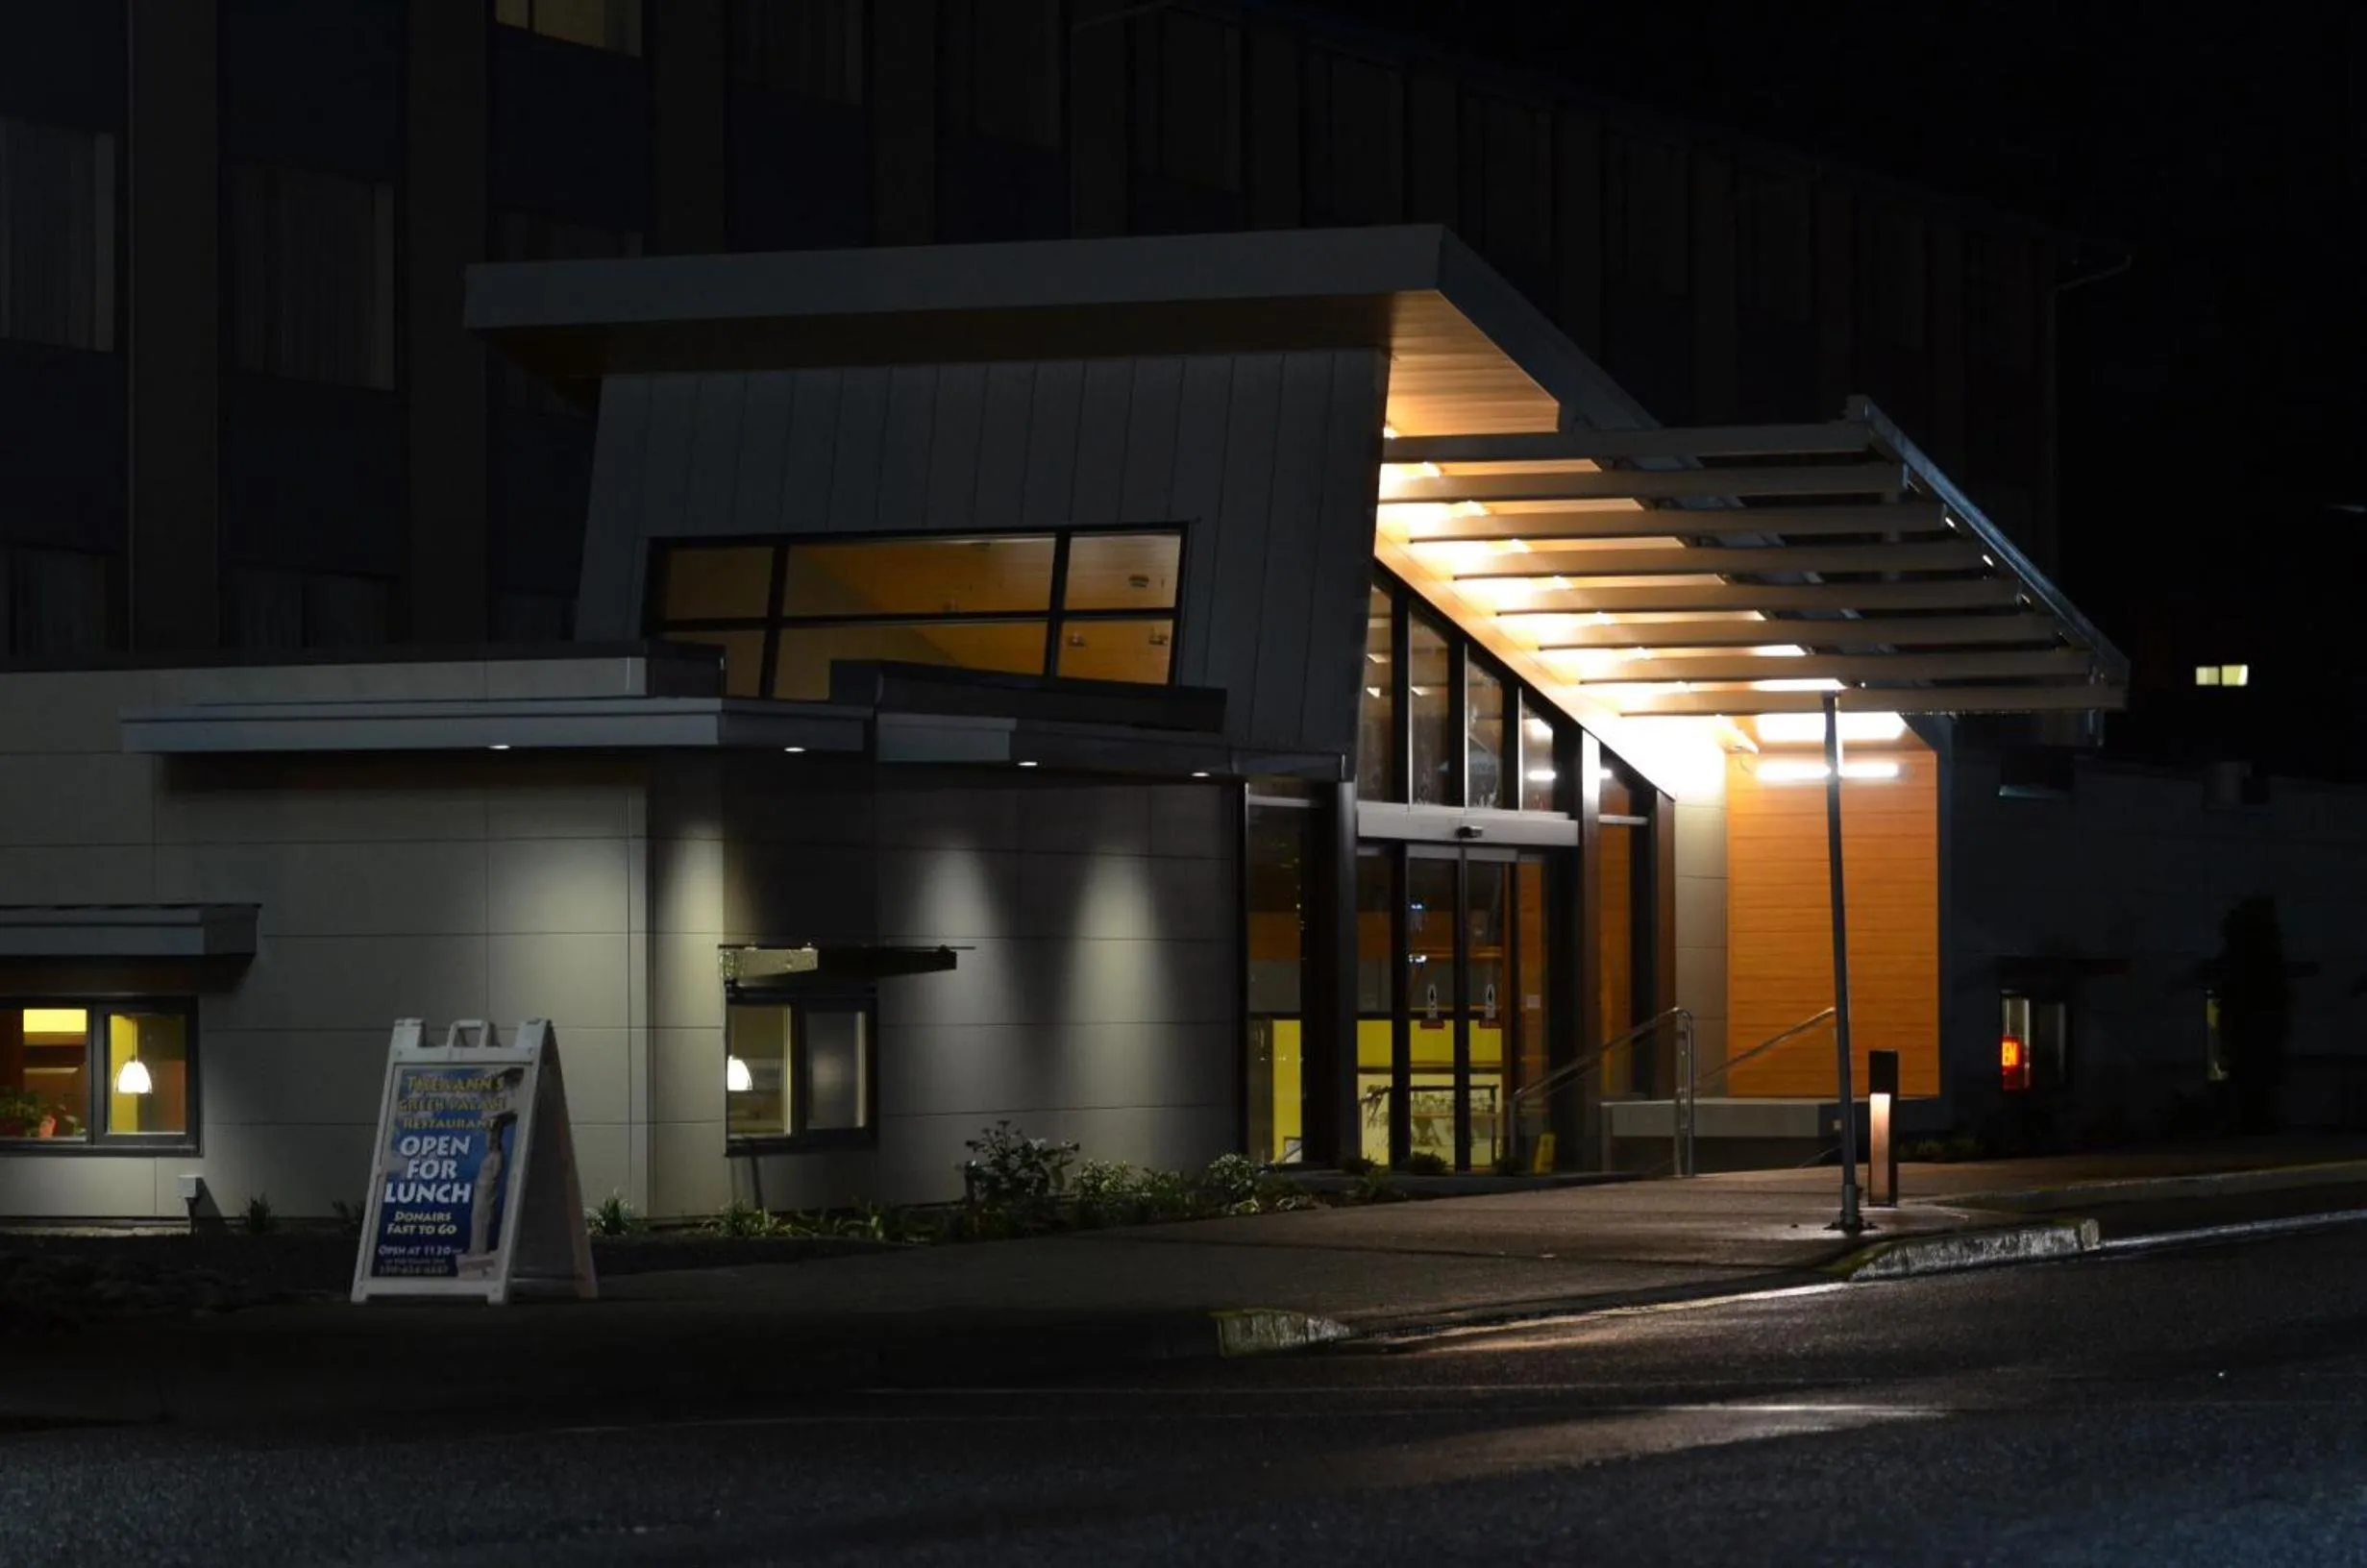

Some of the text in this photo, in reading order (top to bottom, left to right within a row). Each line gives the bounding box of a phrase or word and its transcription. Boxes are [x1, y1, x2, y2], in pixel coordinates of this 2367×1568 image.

[403, 1117, 497, 1131] RESTAURANT
[399, 1135, 472, 1158] OPEN
[406, 1159, 457, 1180] FOR
[383, 1182, 473, 1204] LUNCH
[387, 1222, 457, 1236] FAST TO GO
